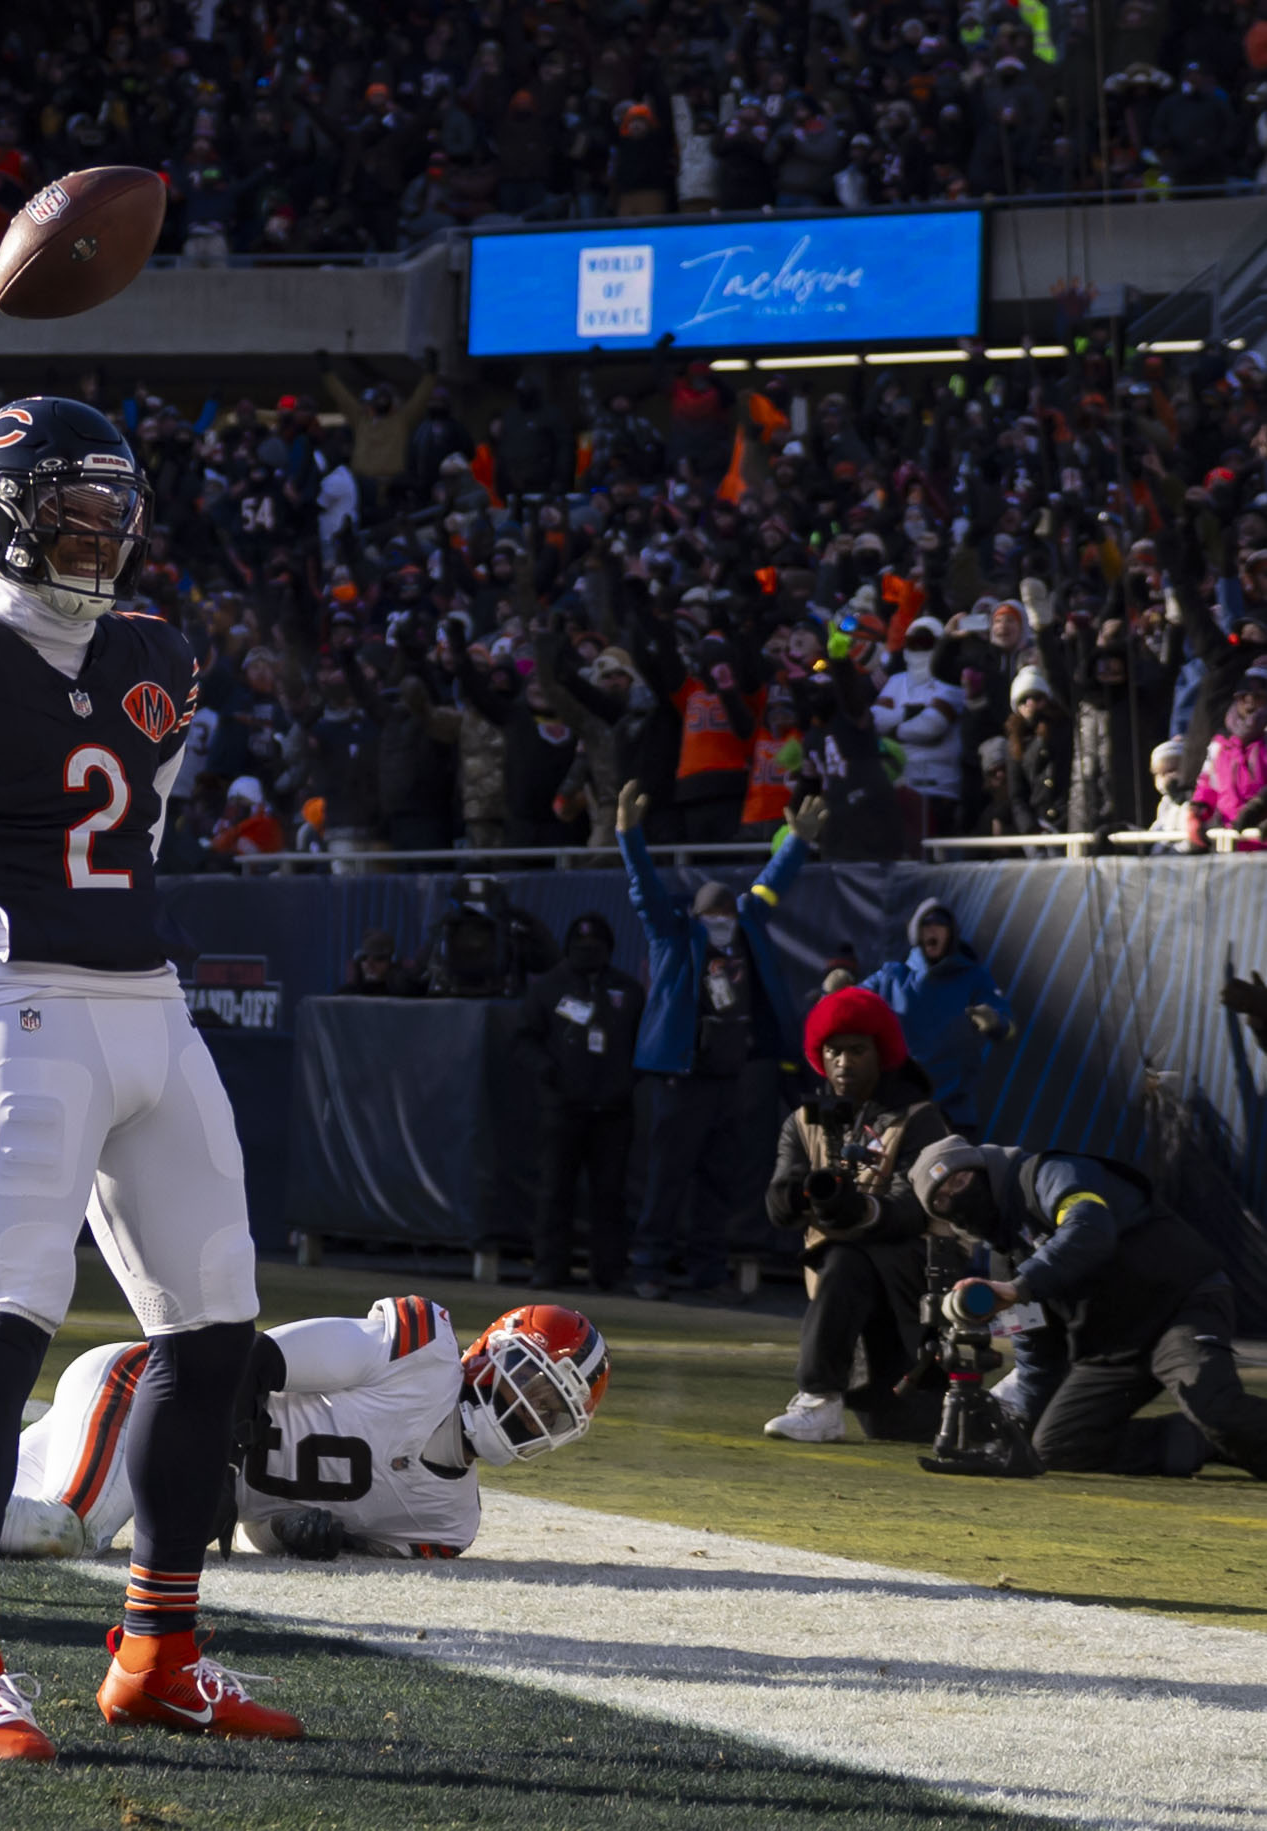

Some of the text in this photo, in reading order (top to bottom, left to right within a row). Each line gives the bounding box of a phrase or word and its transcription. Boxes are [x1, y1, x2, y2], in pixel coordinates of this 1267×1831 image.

[35, 194, 66, 221] NFL
[587, 256, 645, 273] WORLD
[602, 282, 625, 299] OF
[91, 456, 128, 468] BEARS
[241, 497, 274, 531] 54
[63, 743, 133, 890] 2
